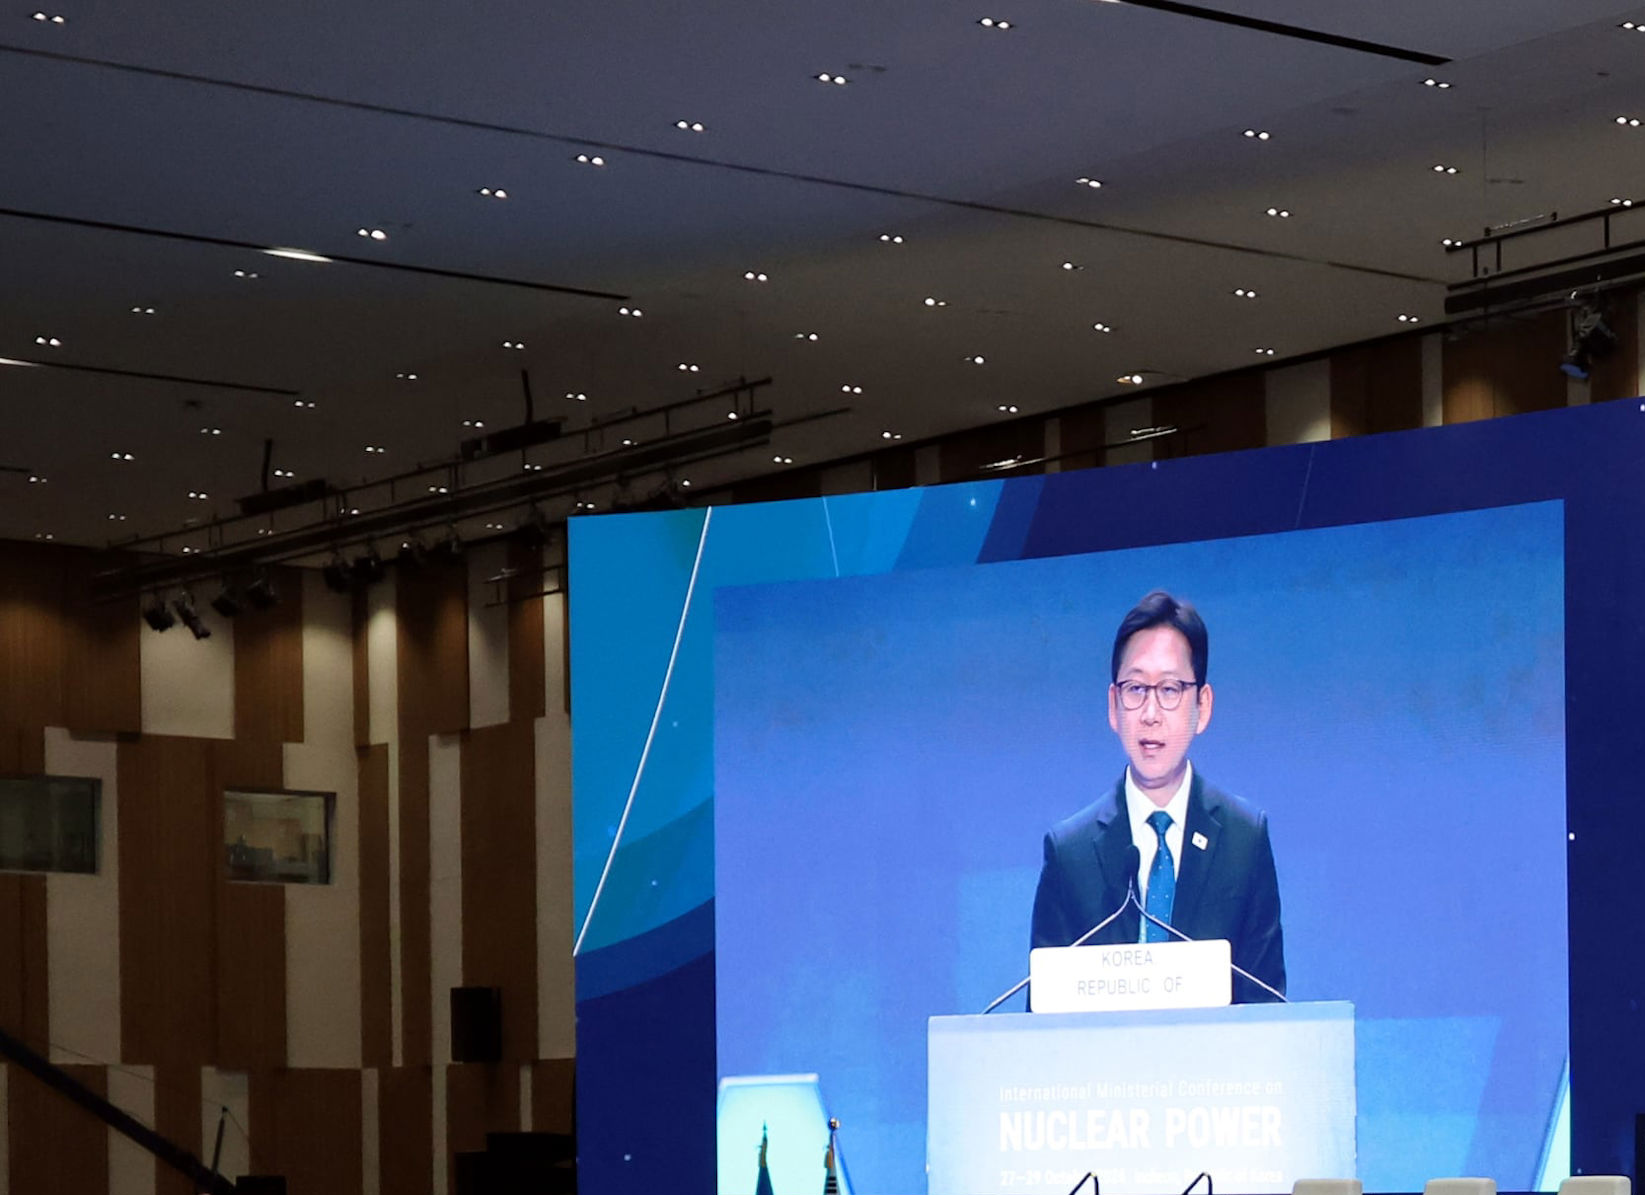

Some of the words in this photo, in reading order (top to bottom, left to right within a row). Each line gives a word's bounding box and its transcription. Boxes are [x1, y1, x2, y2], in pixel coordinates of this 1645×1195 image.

[1077, 977, 1150, 996] REPUBLIC
[1163, 975, 1183, 994] OF
[1000, 1108, 1151, 1152] NUCLEAR
[1164, 1104, 1283, 1149] POWER
